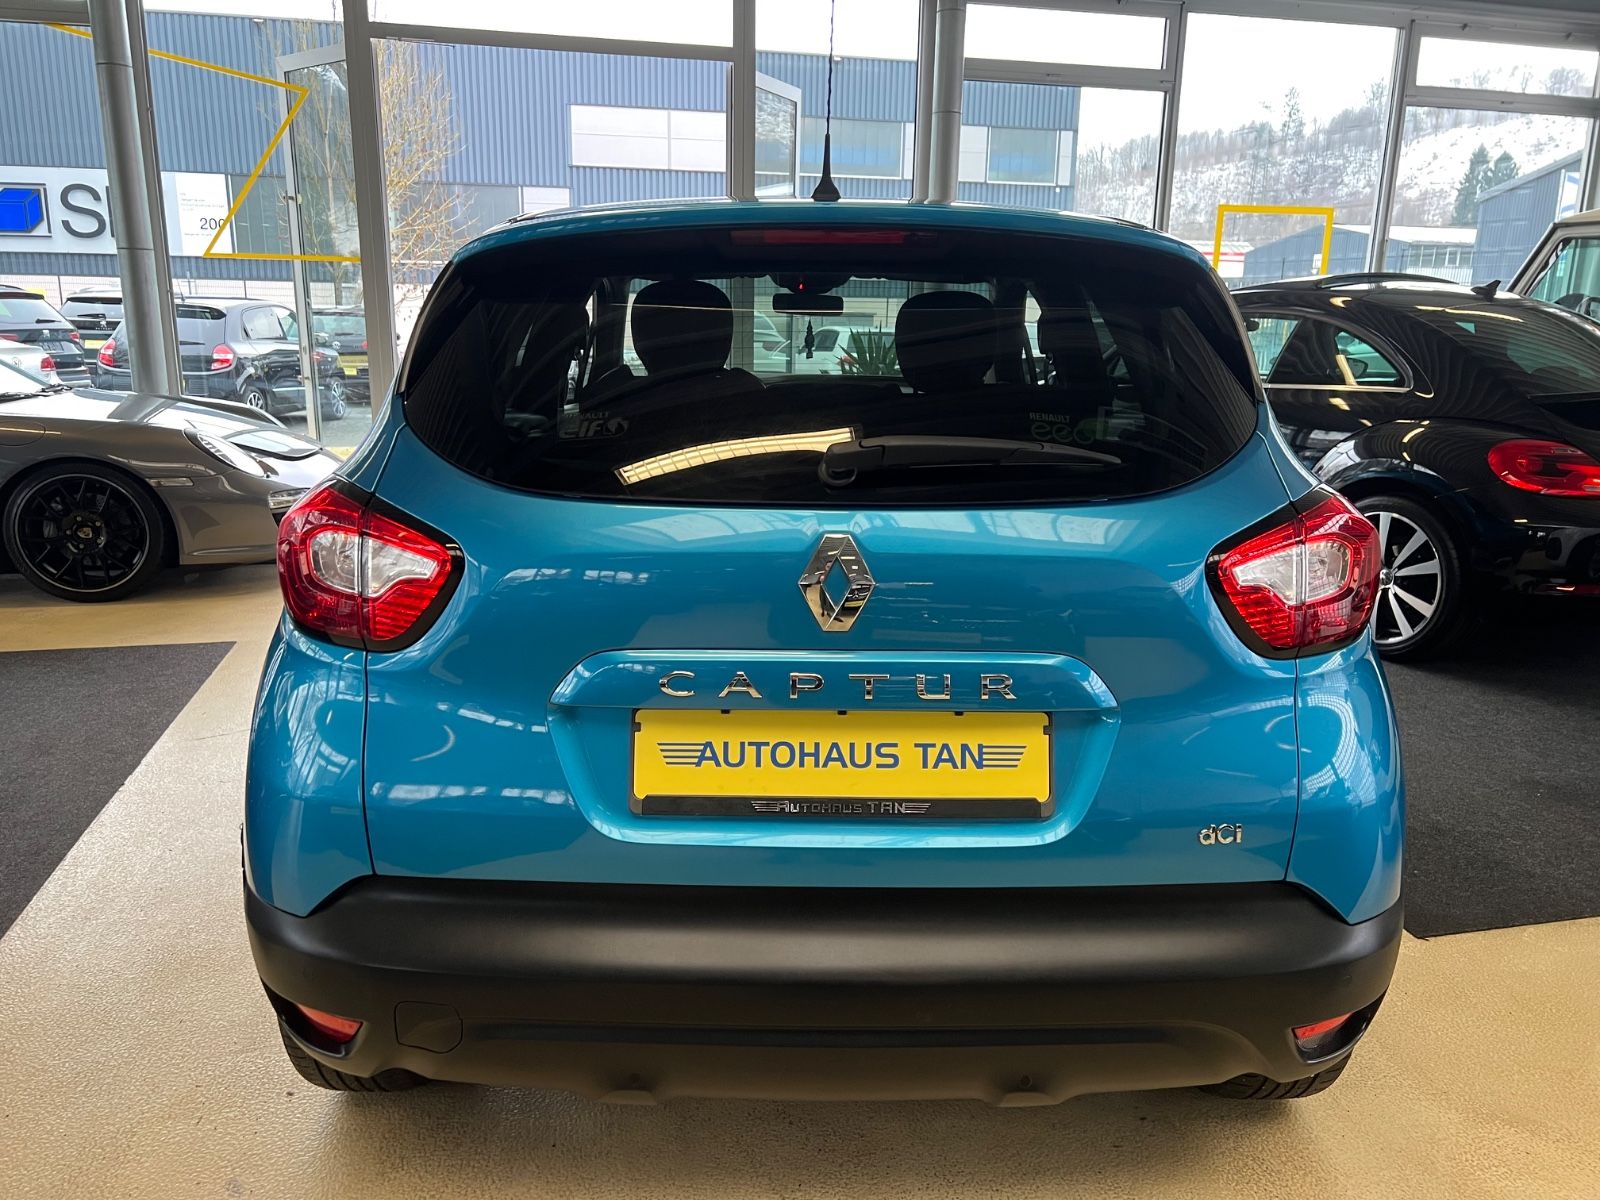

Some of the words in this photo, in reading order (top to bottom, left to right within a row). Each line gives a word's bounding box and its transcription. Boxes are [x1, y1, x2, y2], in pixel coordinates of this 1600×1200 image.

[1029, 411, 1071, 424] RENAULT
[658, 670, 1018, 701] CAPTUR
[695, 740, 900, 769] AUTOHAUS
[914, 742, 984, 770] TAN
[776, 800, 863, 813] AUTOHAUS
[867, 801, 906, 814] TAN
[1199, 823, 1242, 845] dCi
